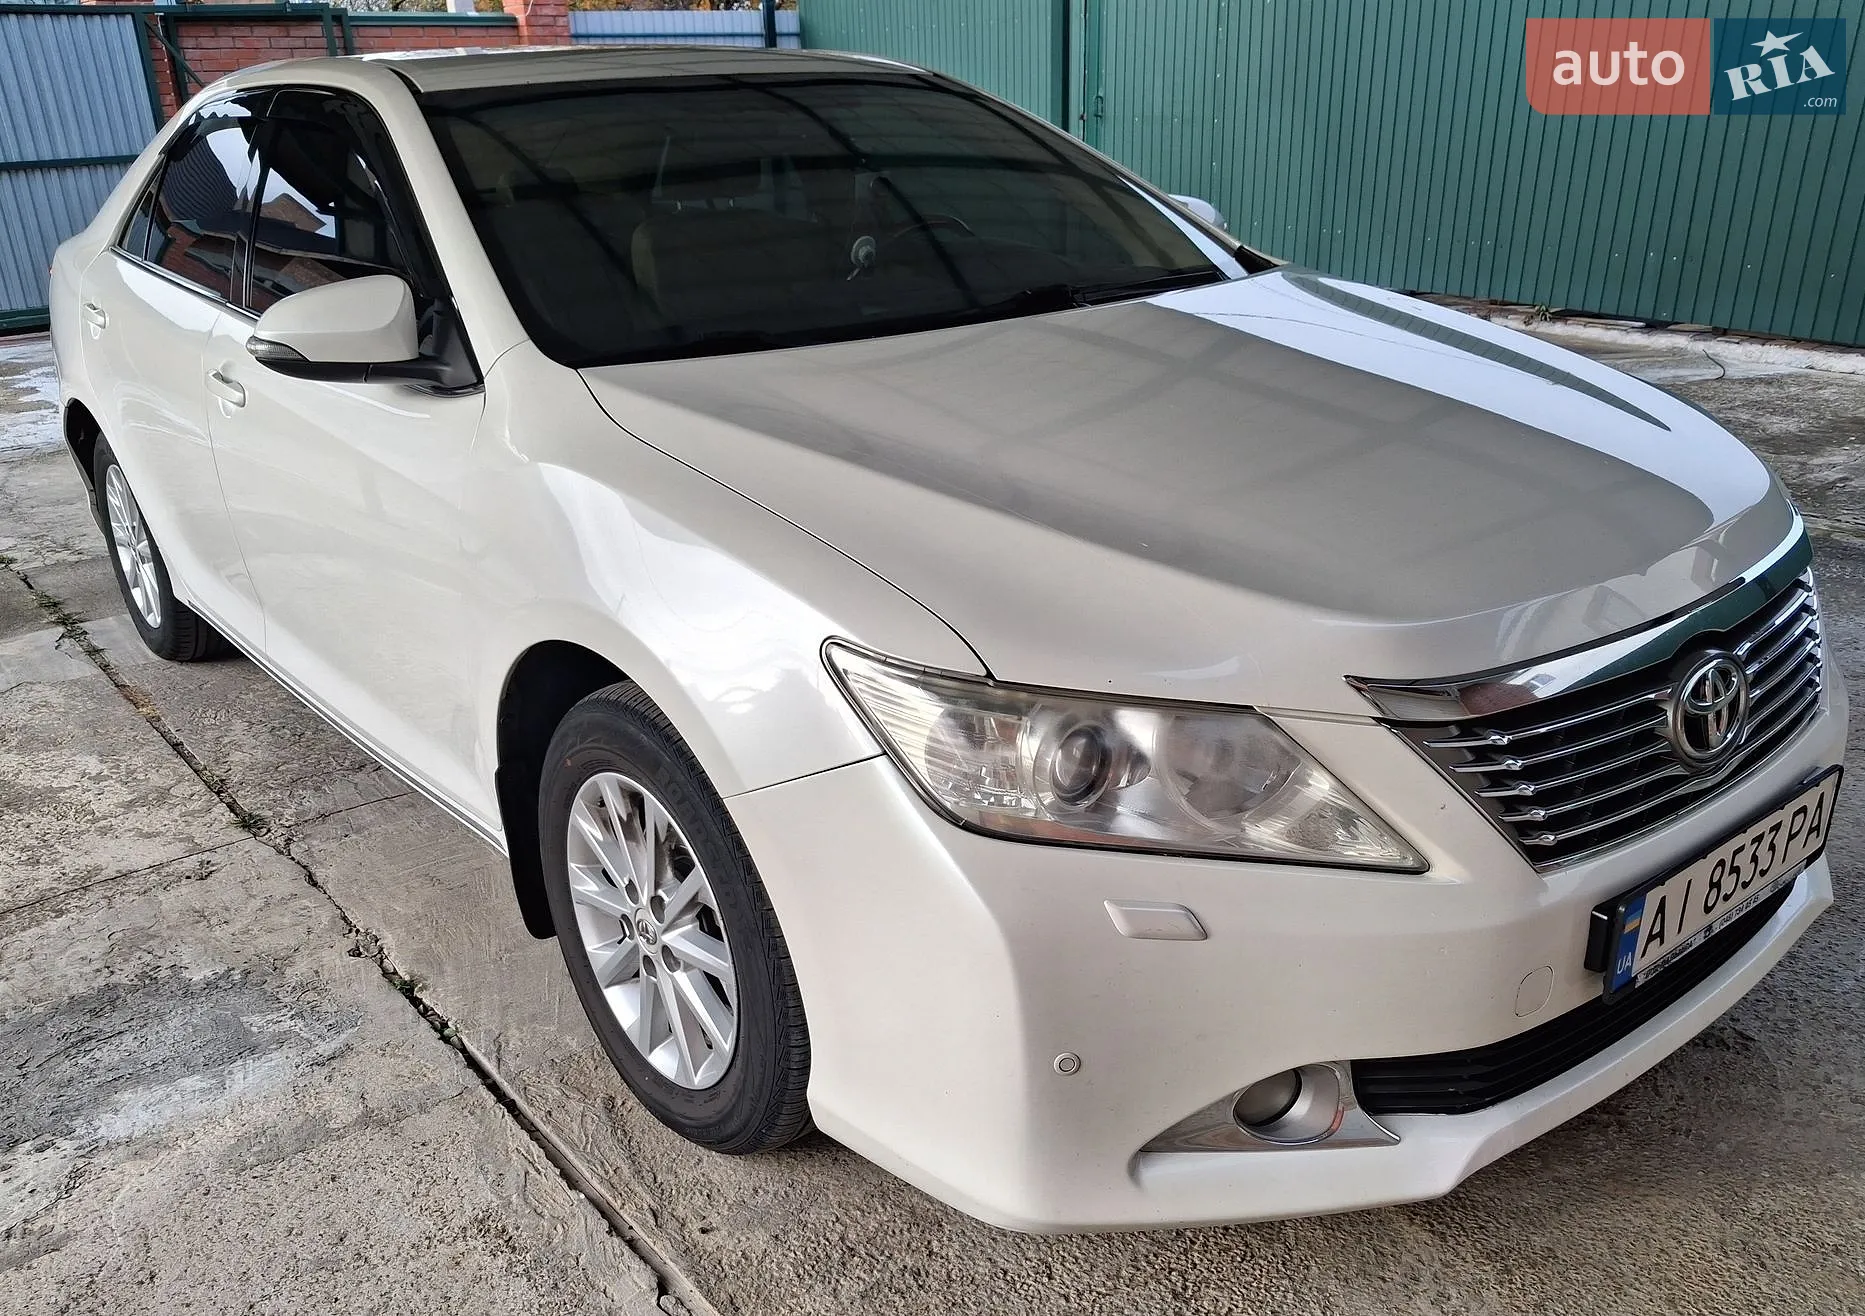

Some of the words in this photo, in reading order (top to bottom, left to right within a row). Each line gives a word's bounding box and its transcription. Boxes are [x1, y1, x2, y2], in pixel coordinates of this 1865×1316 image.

[1640, 878, 1693, 959] AI
[1703, 819, 1783, 914] 8533
[1781, 791, 1825, 864] PA
[1616, 952, 1632, 975] UA
